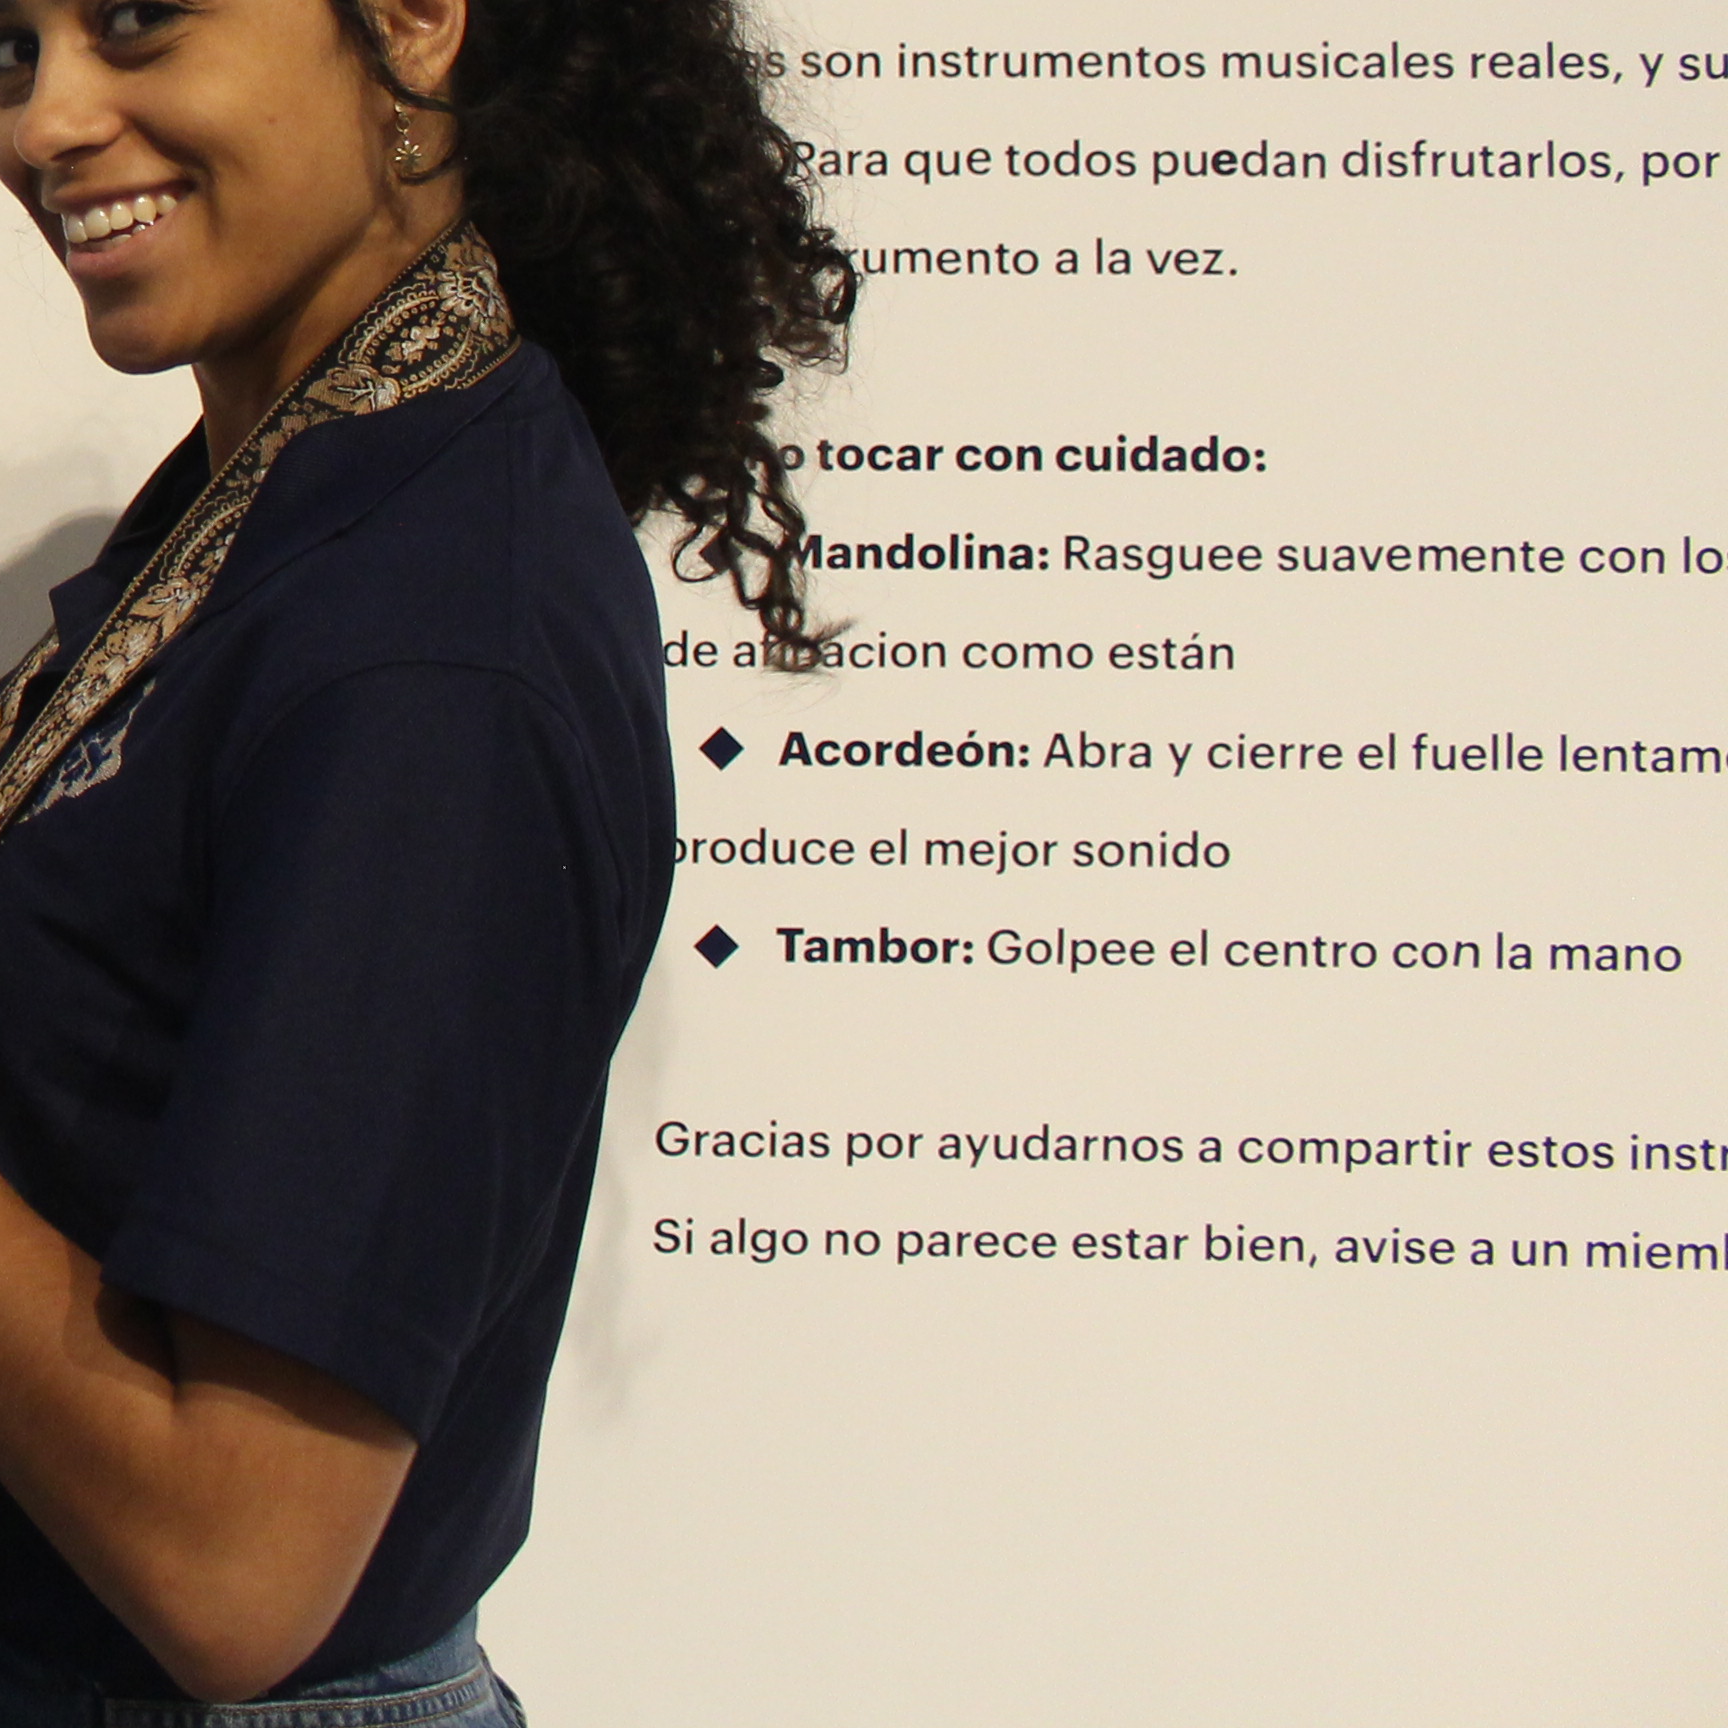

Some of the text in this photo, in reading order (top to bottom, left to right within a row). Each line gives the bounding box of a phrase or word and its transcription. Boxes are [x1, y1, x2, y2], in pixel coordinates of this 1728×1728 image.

[800, 50, 882, 79] son
[898, 41, 1207, 79] instrumentos
[1221, 40, 1455, 80] musicales
[1470, 40, 1623, 85] reales,
[1638, 52, 1665, 89] y
[903, 147, 992, 186] que
[1004, 138, 1137, 178] todos
[1152, 138, 1327, 186] puedan
[1341, 138, 1625, 184] disfrutarlos,
[1642, 151, 1721, 188] por
[1054, 247, 1079, 276] a
[1095, 236, 1132, 276] la
[1145, 248, 1238, 277] vez.
[816, 439, 945, 472] tocar
[954, 444, 1043, 473] con
[1054, 433, 1267, 474] cuidado:
[1063, 534, 1263, 581] Rasguee
[1277, 540, 1566, 574] suavemente
[1579, 546, 1666, 575] con
[1683, 535, 1728, 575] lo
[961, 641, 1094, 670] como
[1108, 631, 1235, 671] están
[778, 729, 1728, 778] Acordeón: Abra y cierre el fuelle lentam
[869, 827, 908, 867] el
[924, 829, 1059, 876] mejor
[1072, 829, 1231, 869] sonido
[775, 926, 1683, 975] Tambor: Golpee el centro con la mano
[655, 1119, 831, 1159] Gracias
[846, 1131, 924, 1168] por
[937, 1122, 1184, 1169] ayudarnos
[1197, 1136, 1223, 1164] a
[1237, 1128, 1473, 1174] compartir
[1487, 1135, 1615, 1170] estos
[652, 1216, 1728, 1271] Si algo no parece estar bien, avise a un miem
